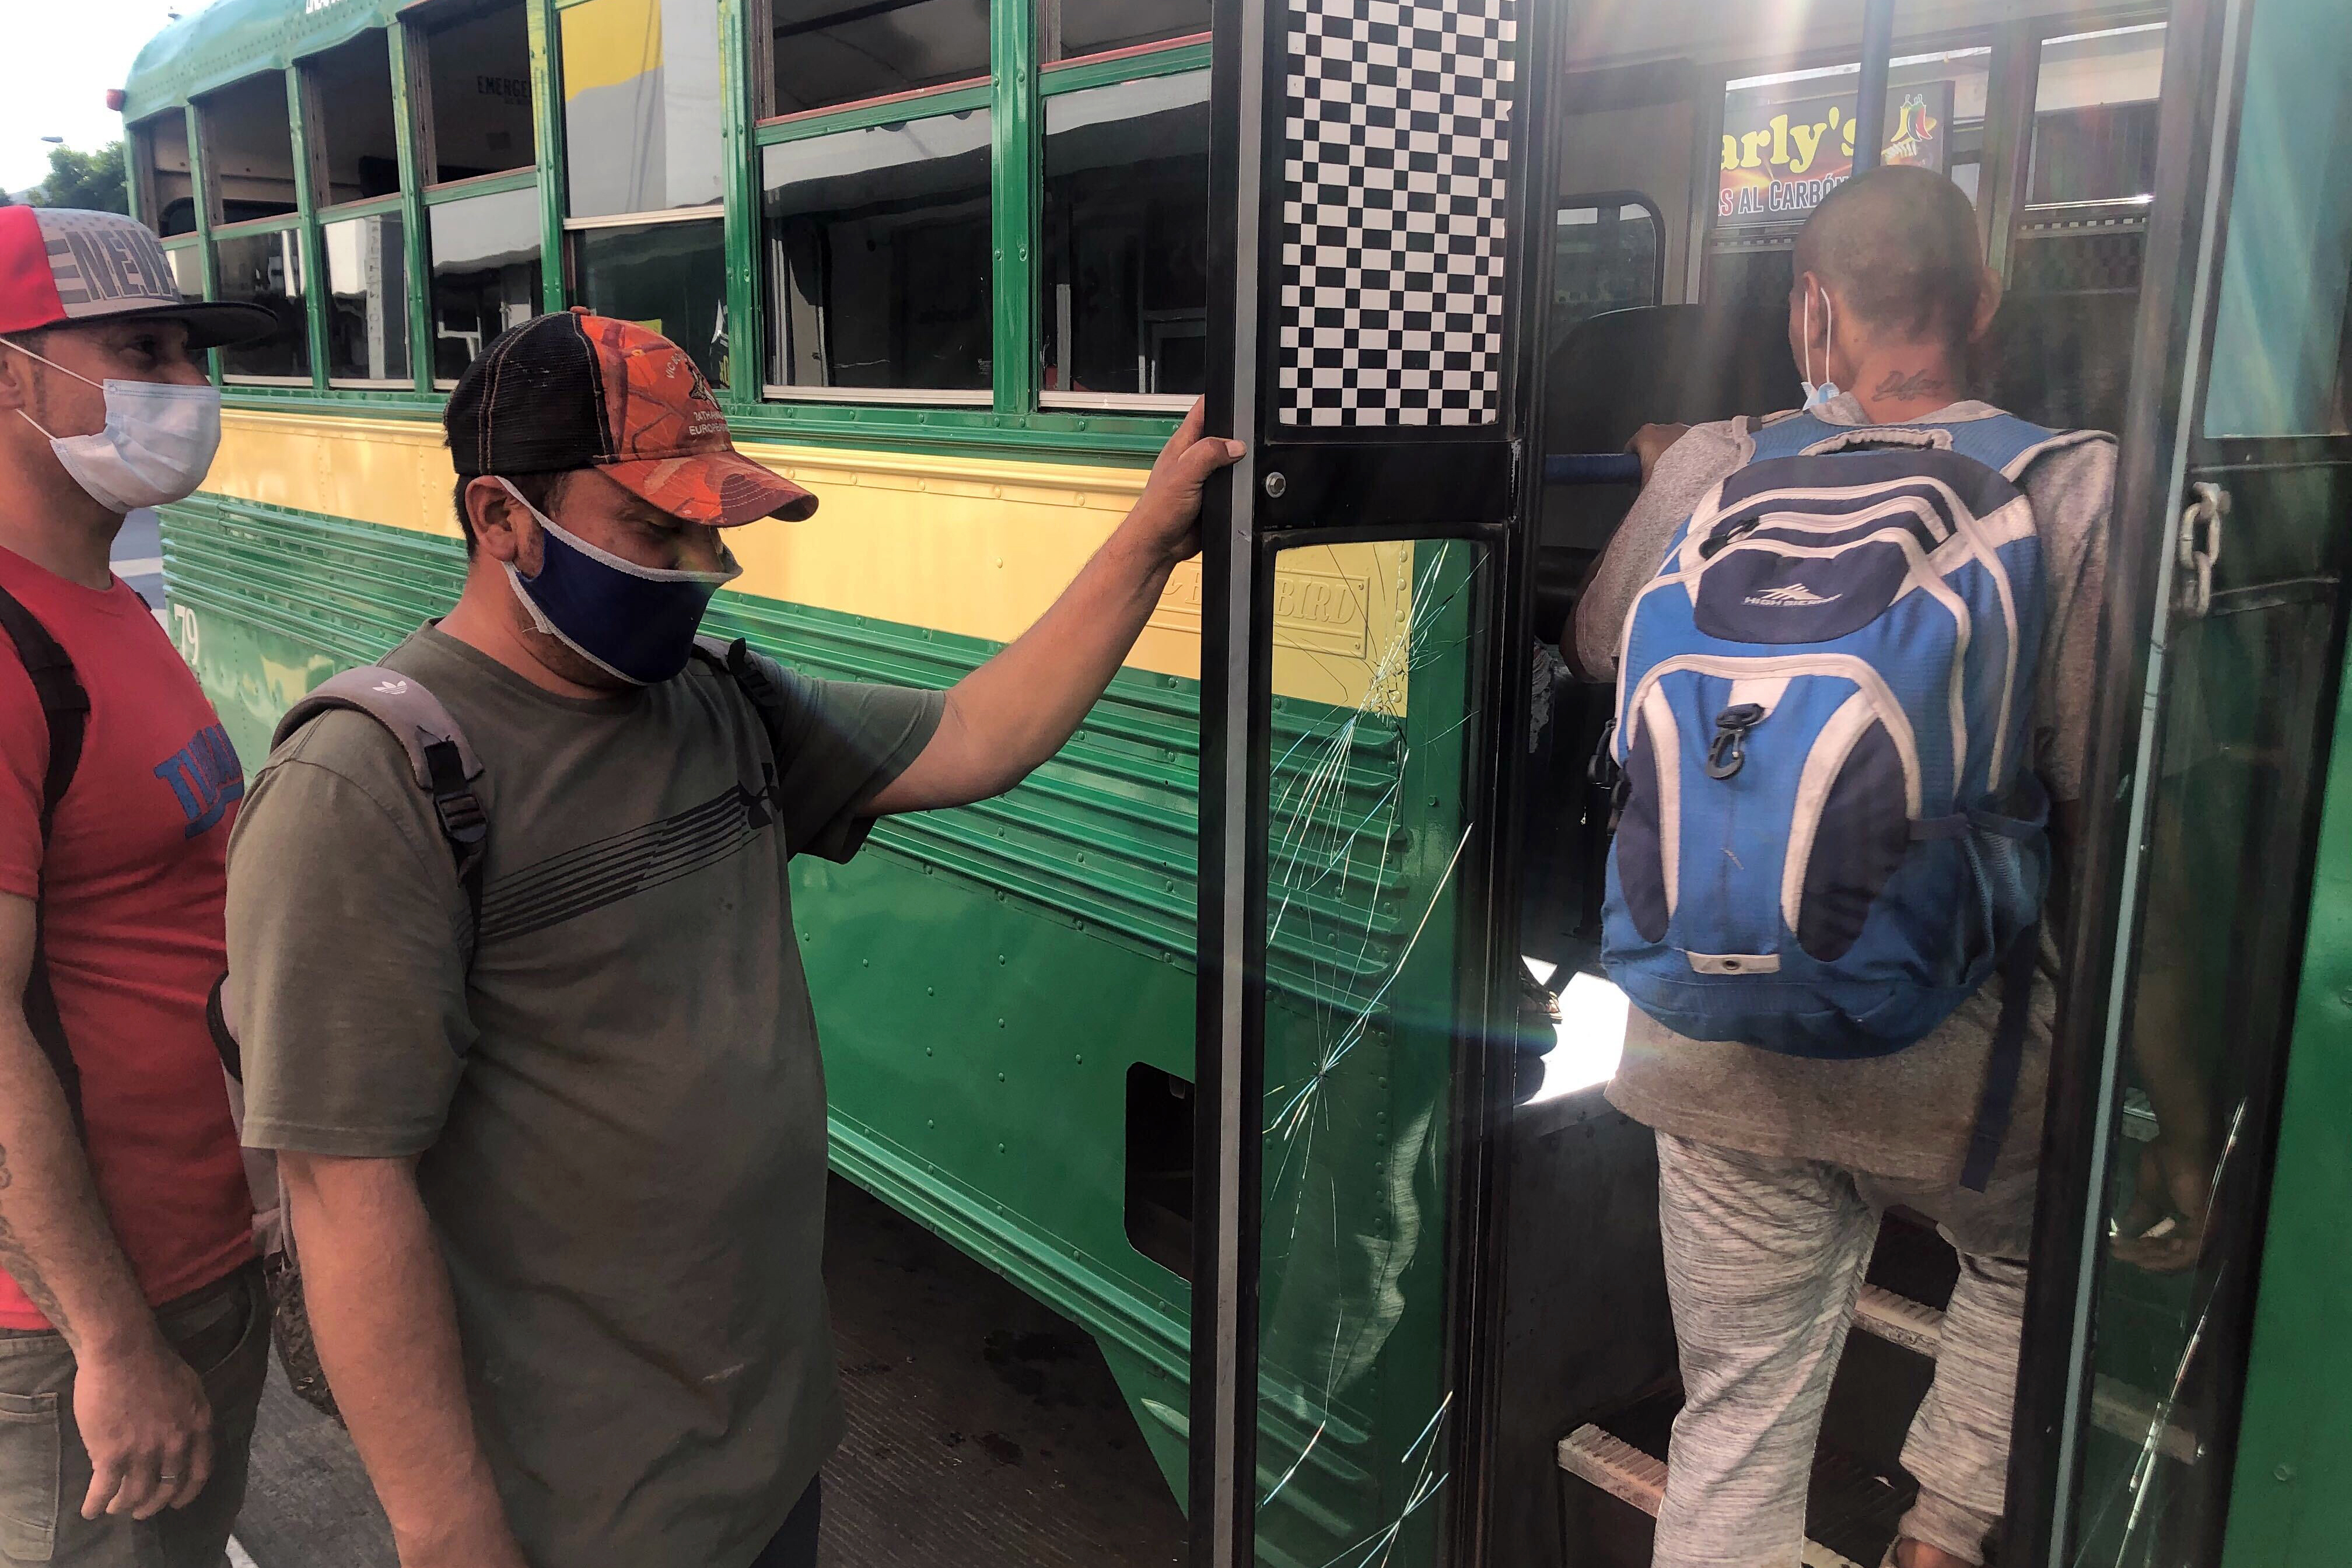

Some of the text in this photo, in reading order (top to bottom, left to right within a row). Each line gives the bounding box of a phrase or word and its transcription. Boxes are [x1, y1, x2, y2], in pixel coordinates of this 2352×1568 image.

[1738, 187, 1763, 215] AL
[1275, 578, 1356, 625] BIRD
[174, 603, 199, 665] 79
